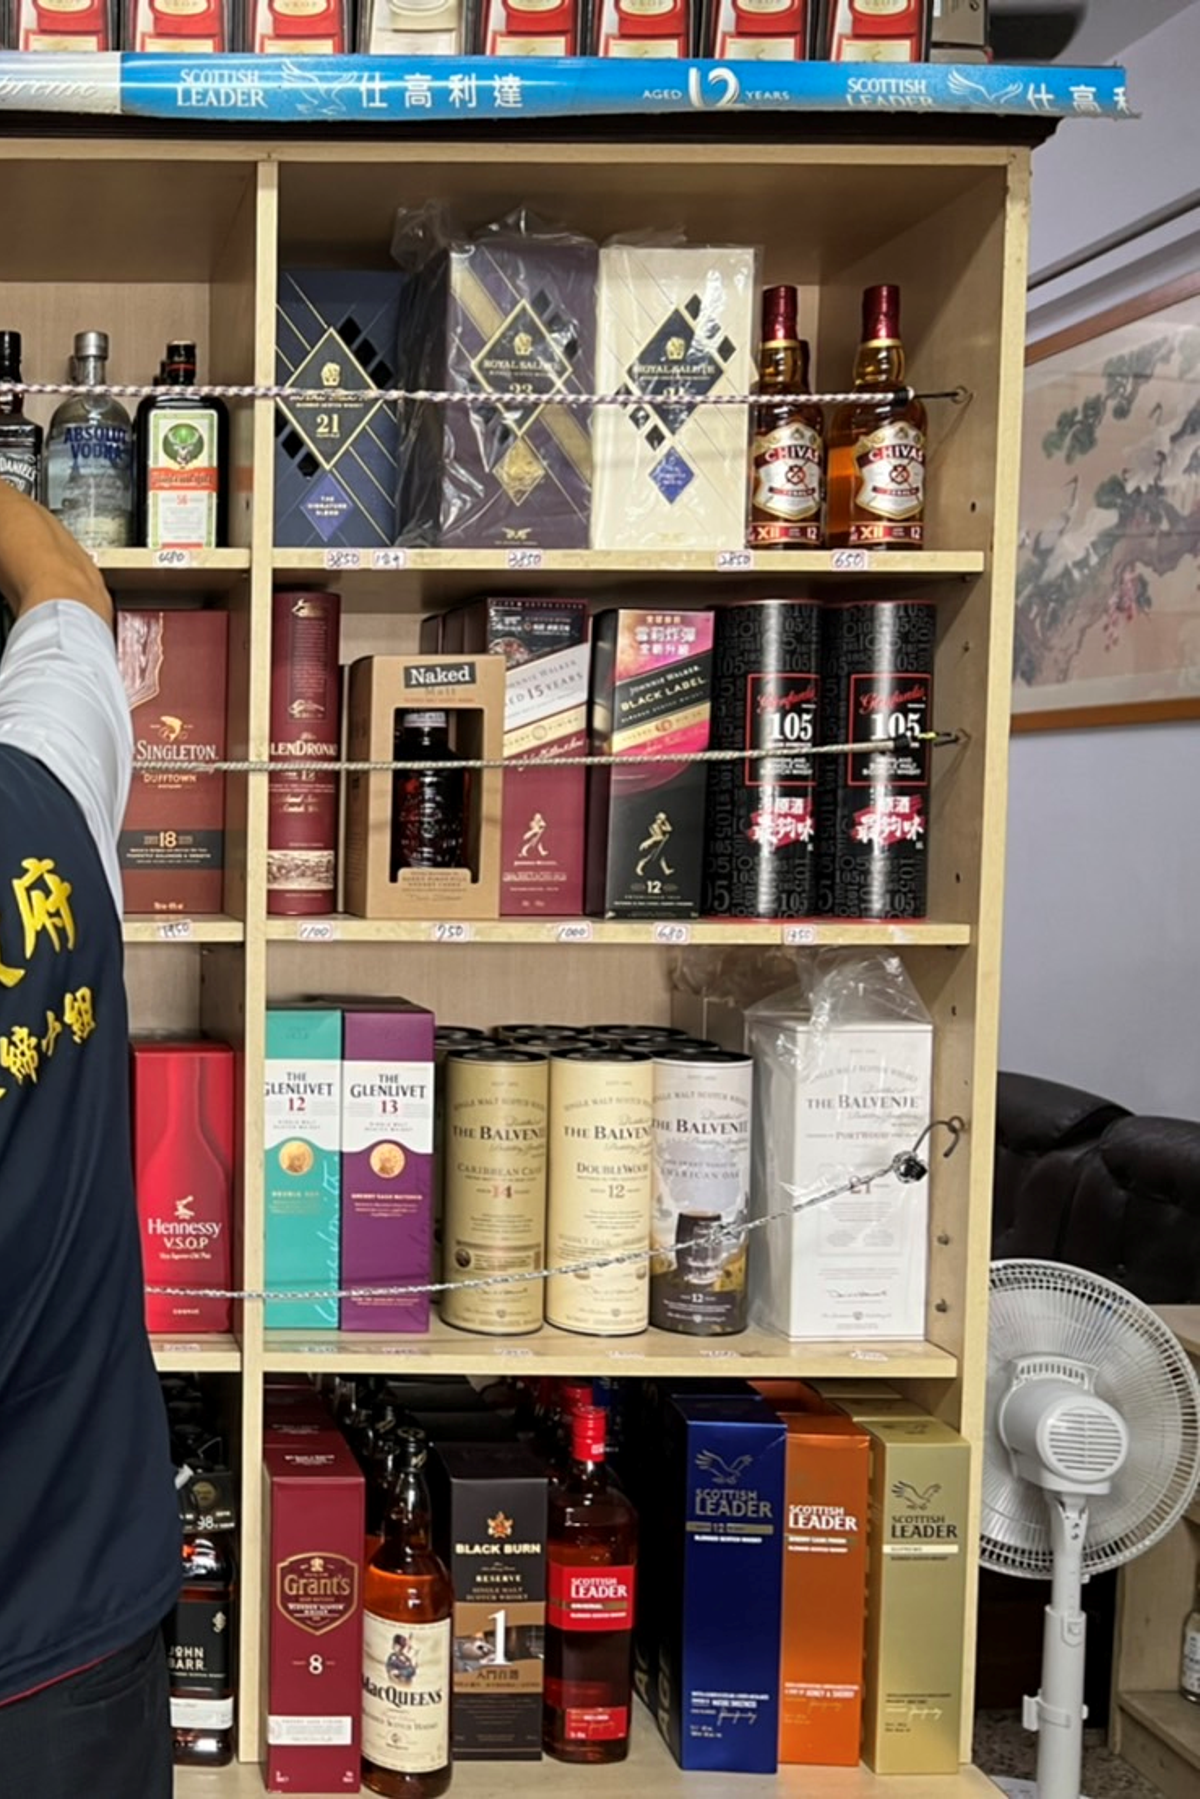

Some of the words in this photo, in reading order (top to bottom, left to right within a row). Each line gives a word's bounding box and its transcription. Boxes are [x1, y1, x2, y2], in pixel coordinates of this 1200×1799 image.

[179, 68, 261, 87] SCOTTISH
[847, 76, 927, 95] SCOTTISH
[359, 72, 525, 109] 仕高利達
[642, 88, 682, 101] AGED
[687, 66, 743, 109] 12
[744, 89, 790, 102] YEARS
[176, 86, 268, 108] LEADER
[315, 414, 340, 434] 21
[64, 425, 129, 444] ABSOLUT
[71, 443, 126, 461] VODKA
[408, 665, 471, 686] Naked
[526, 684, 545, 701] 15
[545, 671, 584, 693] YEARS
[620, 689, 663, 712] BLACK
[665, 676, 708, 696] LABEL
[770, 712, 814, 741] 105
[870, 712, 921, 741] 105
[136, 739, 219, 762] SINGLETON
[143, 773, 197, 784] DUFFTOWN
[158, 831, 177, 848] 18
[646, 881, 662, 894] 12
[286, 1072, 308, 1083] THE
[378, 1074, 400, 1085] THE
[264, 1082, 334, 1097] GLENLIVET
[350, 1084, 428, 1099] GLENLIVET
[288, 1097, 306, 1112] 12
[379, 1099, 399, 1114] 13
[806, 1097, 836, 1110] THE
[836, 1094, 920, 1110] BALVENIE
[452, 1125, 475, 1140] THE
[564, 1126, 589, 1140] THE
[593, 1126, 650, 1142] BALVEN
[491, 1185, 513, 1200] 14
[607, 1184, 626, 1200] 12
[147, 1217, 222, 1239] Hennessy
[163, 1236, 209, 1250] V.S.O.P
[694, 1488, 758, 1501] SCOTTISH
[694, 1500, 773, 1518] LEADER
[788, 1504, 845, 1517] SCOTTISH
[788, 1516, 858, 1532] LEADER
[890, 1515, 945, 1525] SCOTTISH
[890, 1523, 958, 1539] LEADER
[455, 1543, 502, 1556] BLACK
[503, 1542, 542, 1555] BURN
[284, 1573, 351, 1597] Grant's
[474, 1573, 522, 1583] RESERVE
[570, 1577, 618, 1587] SCOTTISH
[570, 1585, 628, 1599] LEADER
[486, 1609, 513, 1667] 1
[308, 1654, 324, 1676] 8
